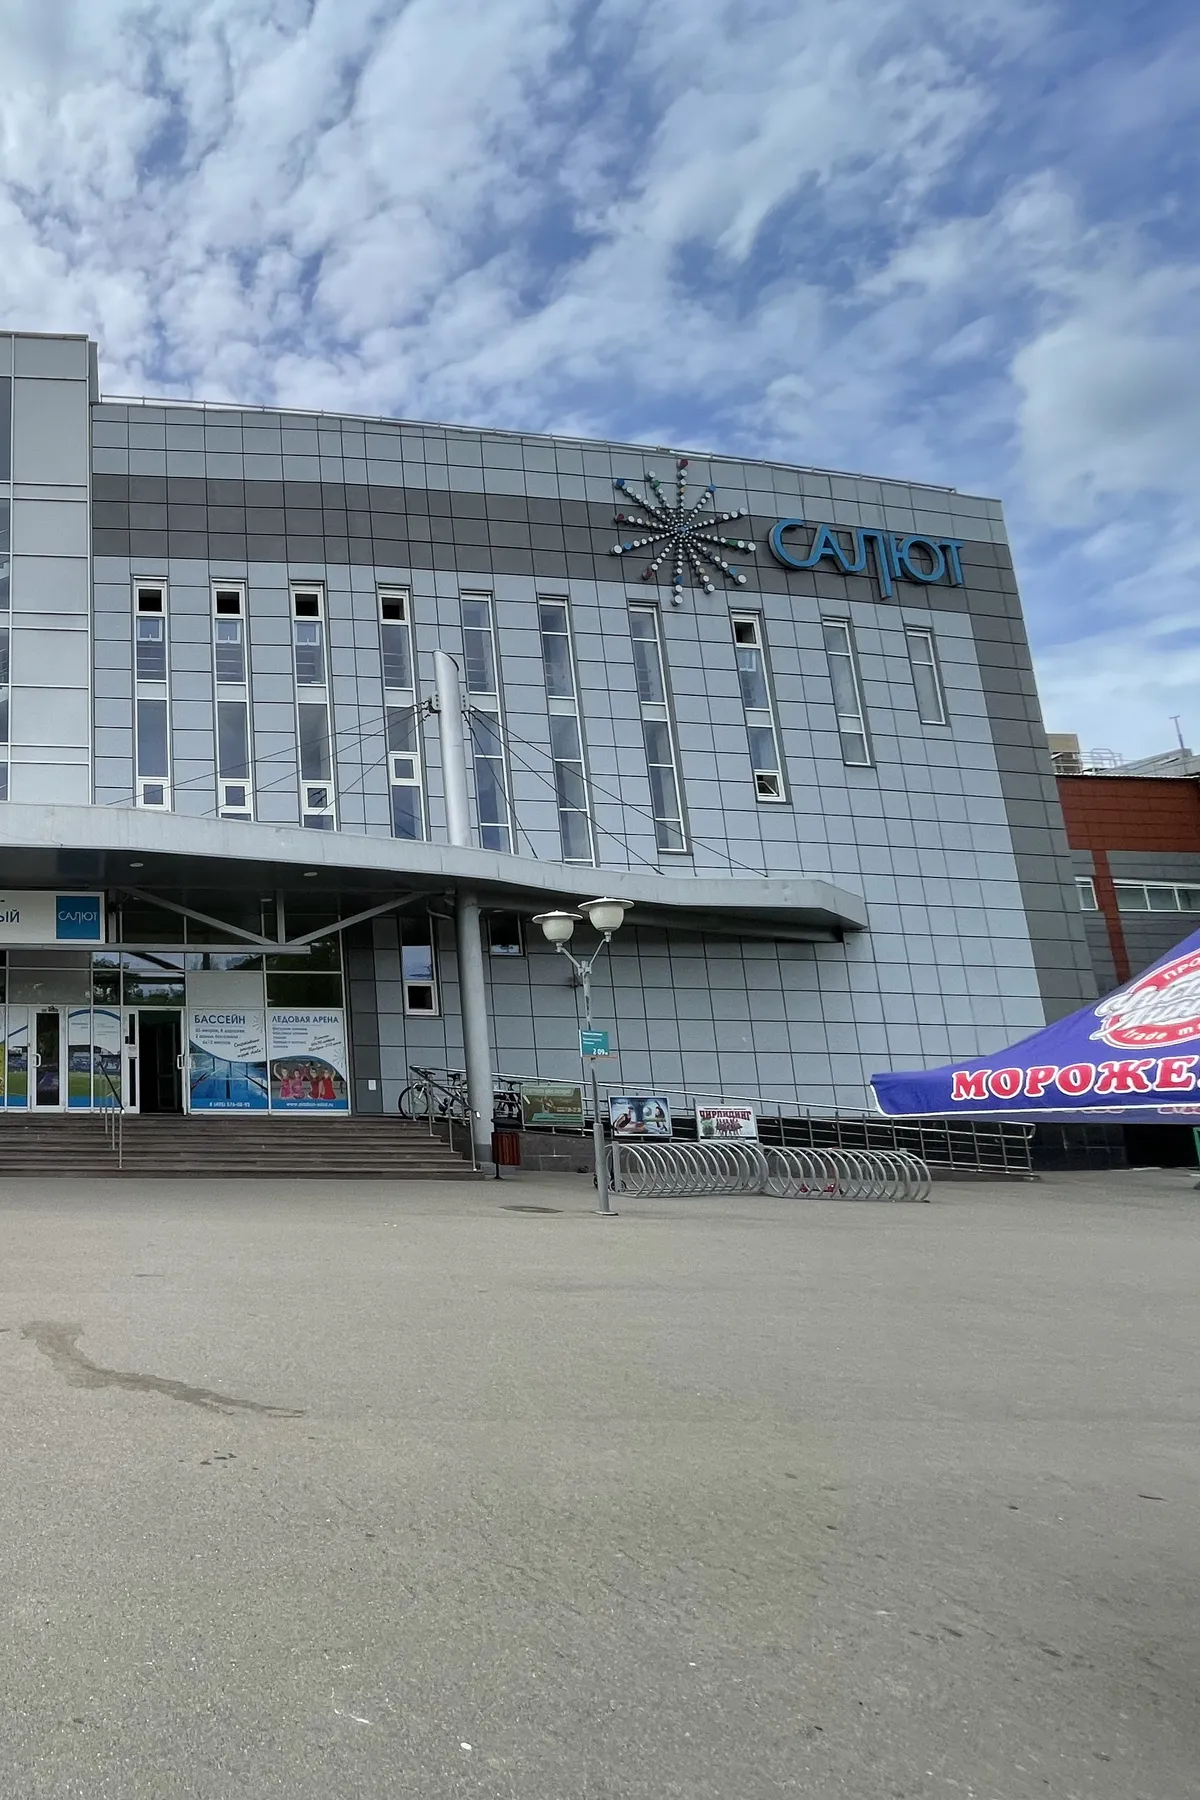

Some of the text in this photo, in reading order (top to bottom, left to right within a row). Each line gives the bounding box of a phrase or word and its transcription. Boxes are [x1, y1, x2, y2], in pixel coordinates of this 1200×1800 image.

[768, 518, 963, 598] САЛЮТ
[58, 910, 98, 925] САЛЮТ
[194, 1013, 246, 1025] БАССЕЙН
[272, 1015, 339, 1024] ЛЕДОВАЯ АРЕНА
[1122, 1029, 1168, 1041] trade
[952, 1055, 1200, 1101] МОРОЖЕ
[699, 1110, 751, 1121] ЧИРЛИДИНГ
